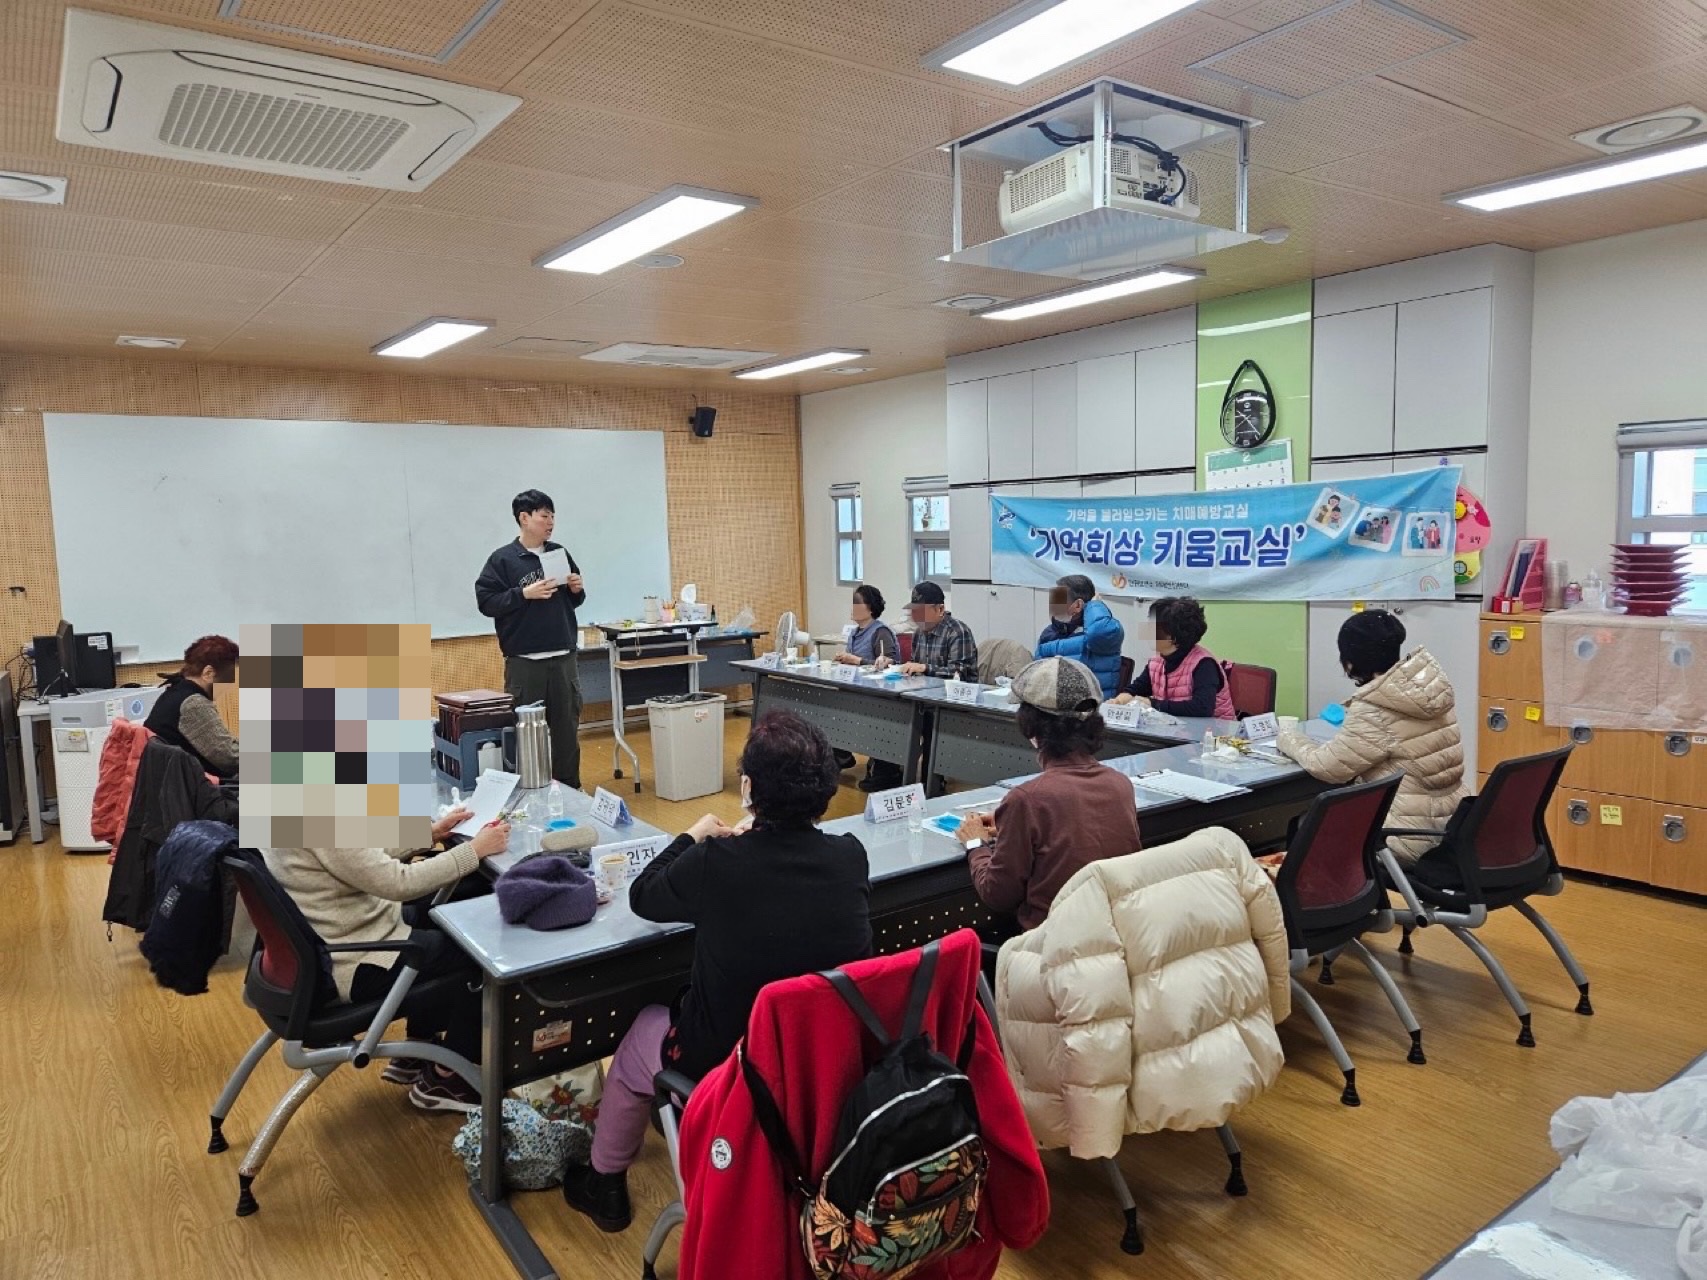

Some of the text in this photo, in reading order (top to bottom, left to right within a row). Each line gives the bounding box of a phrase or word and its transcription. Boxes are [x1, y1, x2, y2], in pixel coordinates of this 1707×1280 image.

[1242, 452, 1251, 462] 2
[1066, 503, 1248, 522] 기억을 불러일으키는 치매예방교실
[1030, 524, 1305, 567] '기억회상 키움교실'
